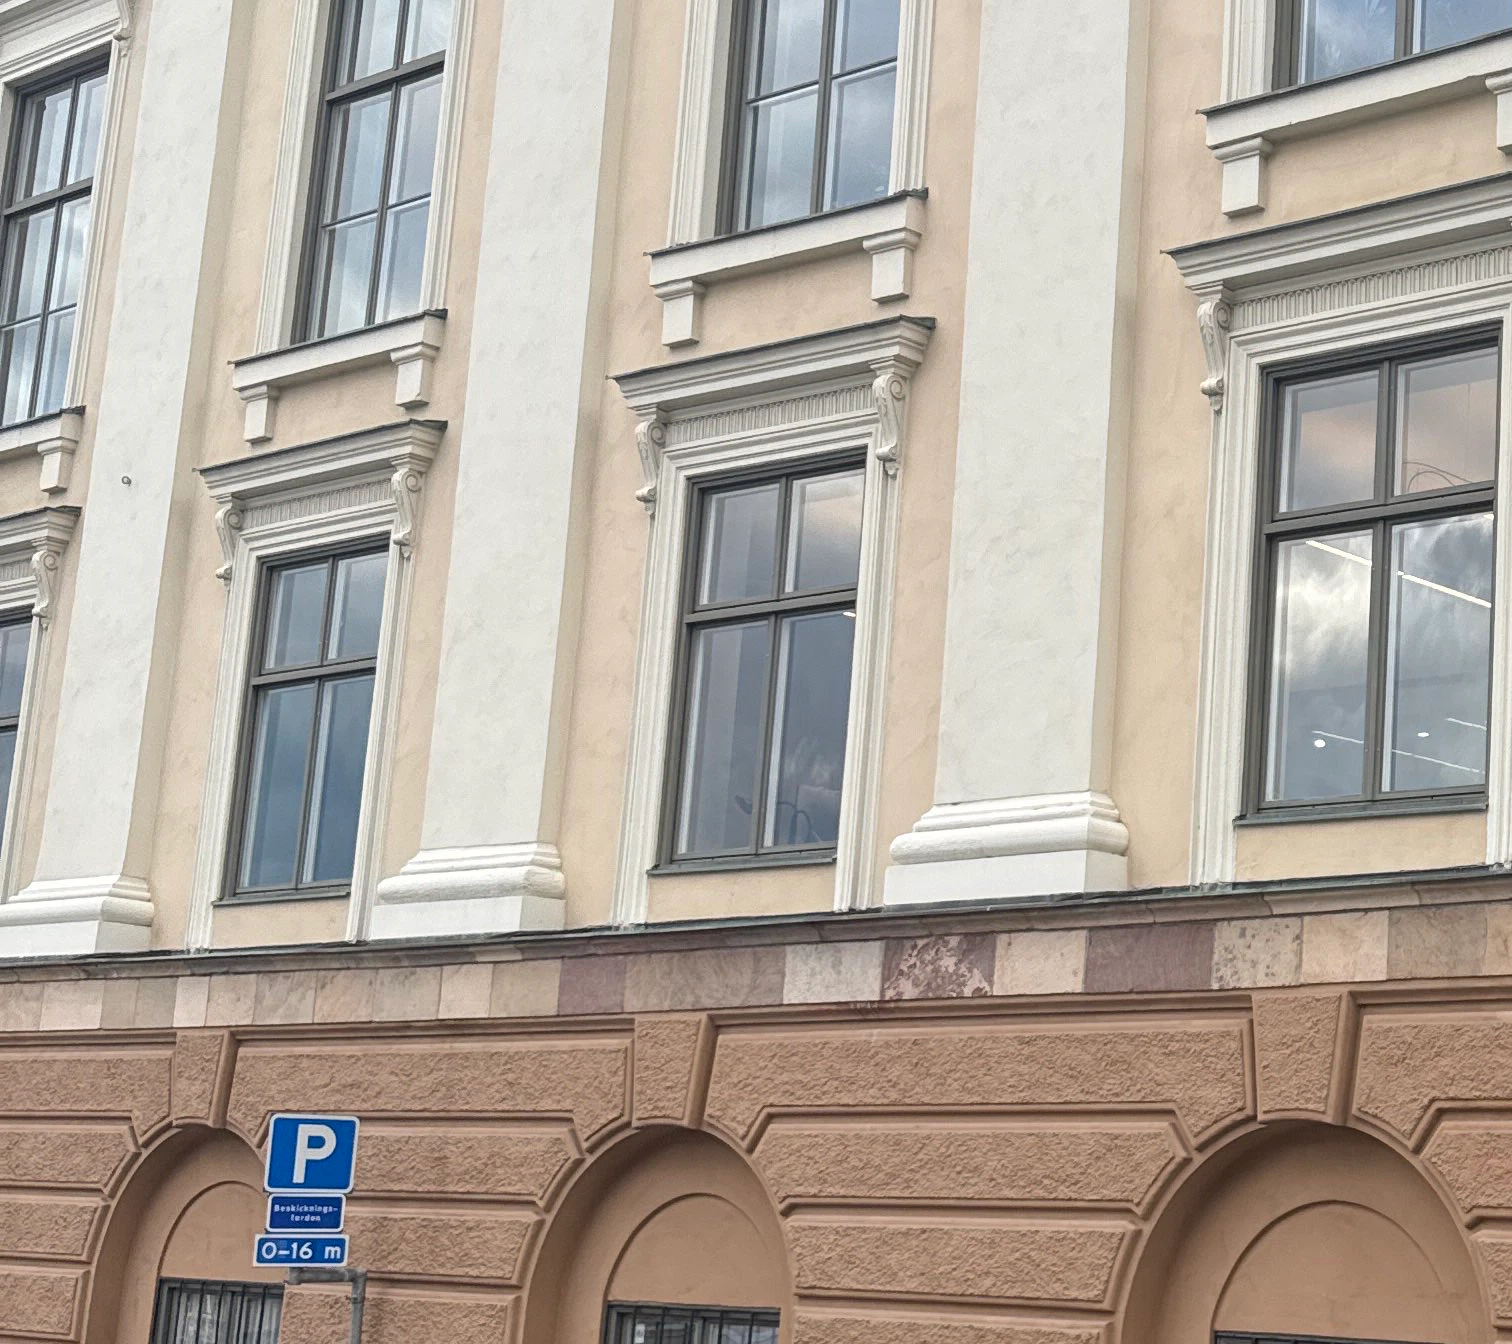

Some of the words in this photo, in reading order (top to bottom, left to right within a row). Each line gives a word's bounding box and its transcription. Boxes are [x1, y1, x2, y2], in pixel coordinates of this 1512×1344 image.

[292, 1123, 337, 1184] P
[261, 1241, 313, 1260] 0-16
[323, 1245, 342, 1260] m
